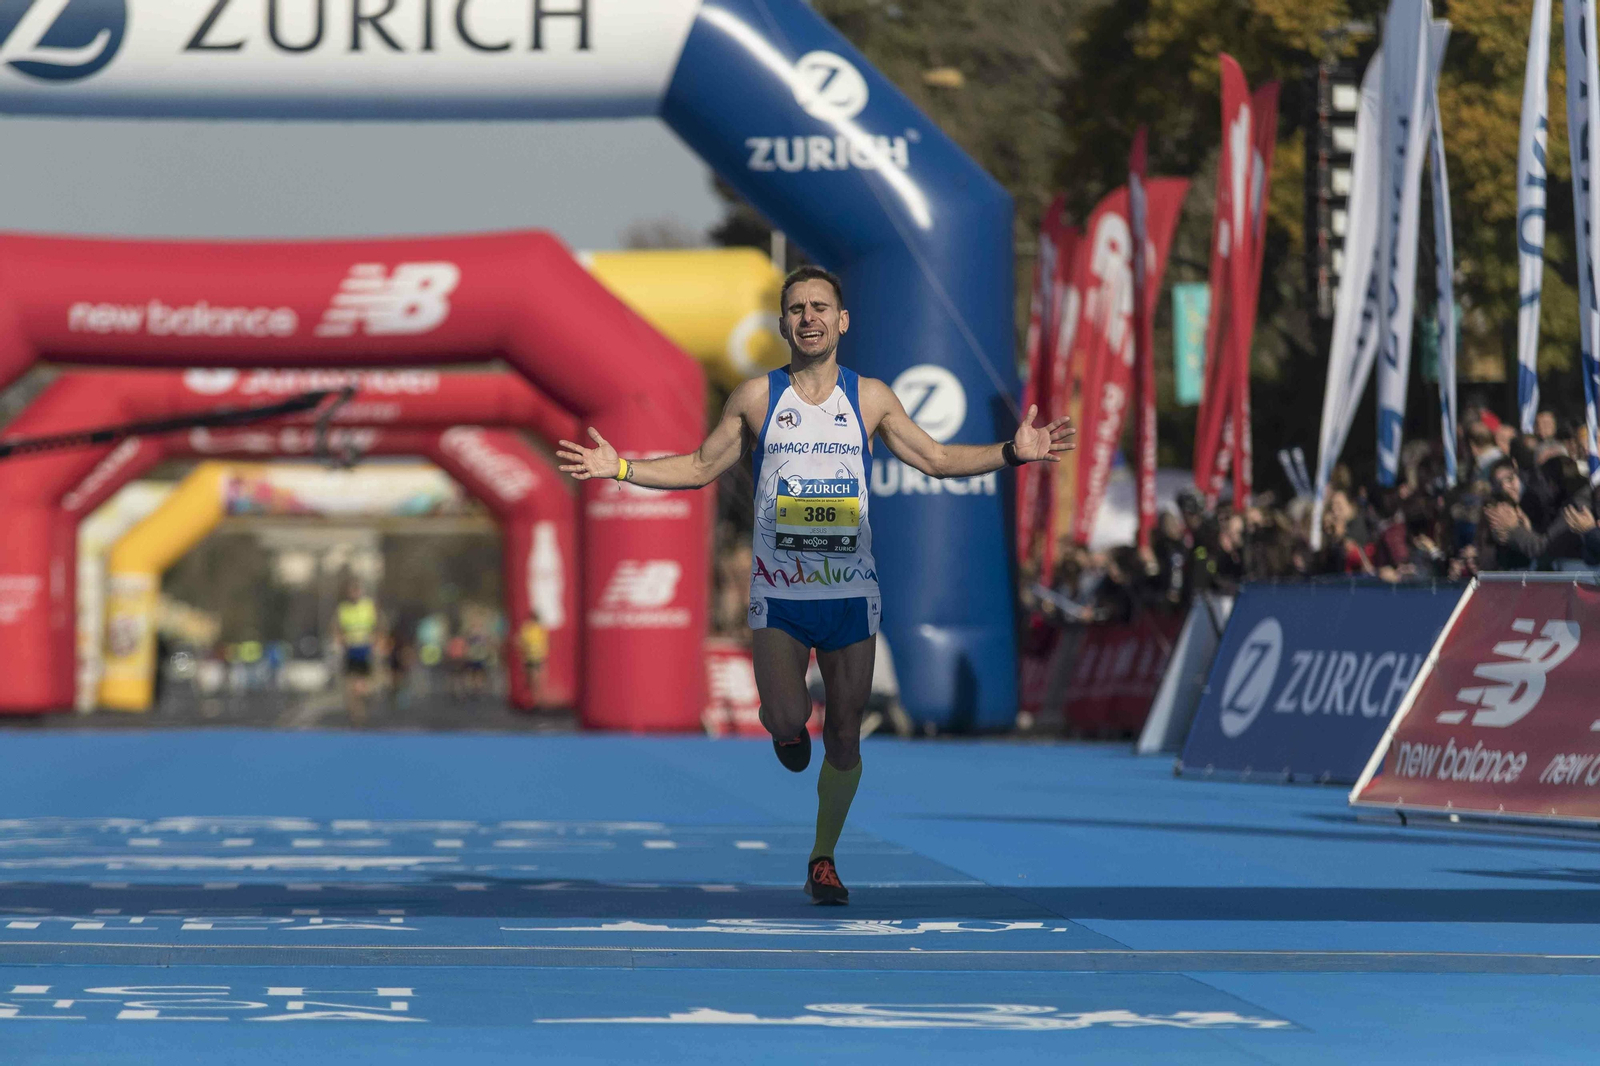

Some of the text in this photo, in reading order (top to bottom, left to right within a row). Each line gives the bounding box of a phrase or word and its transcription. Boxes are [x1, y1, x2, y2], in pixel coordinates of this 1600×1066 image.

[181, 0, 594, 53] ZURICH
[745, 135, 909, 171] ZURICH
[67, 299, 297, 337] new balance
[811, 442, 860, 456] ATLETISMO
[805, 484, 850, 494] ZURICH
[804, 507, 836, 522] 386
[1274, 650, 1423, 717] ZURICH
[1395, 737, 1528, 784] new balance
